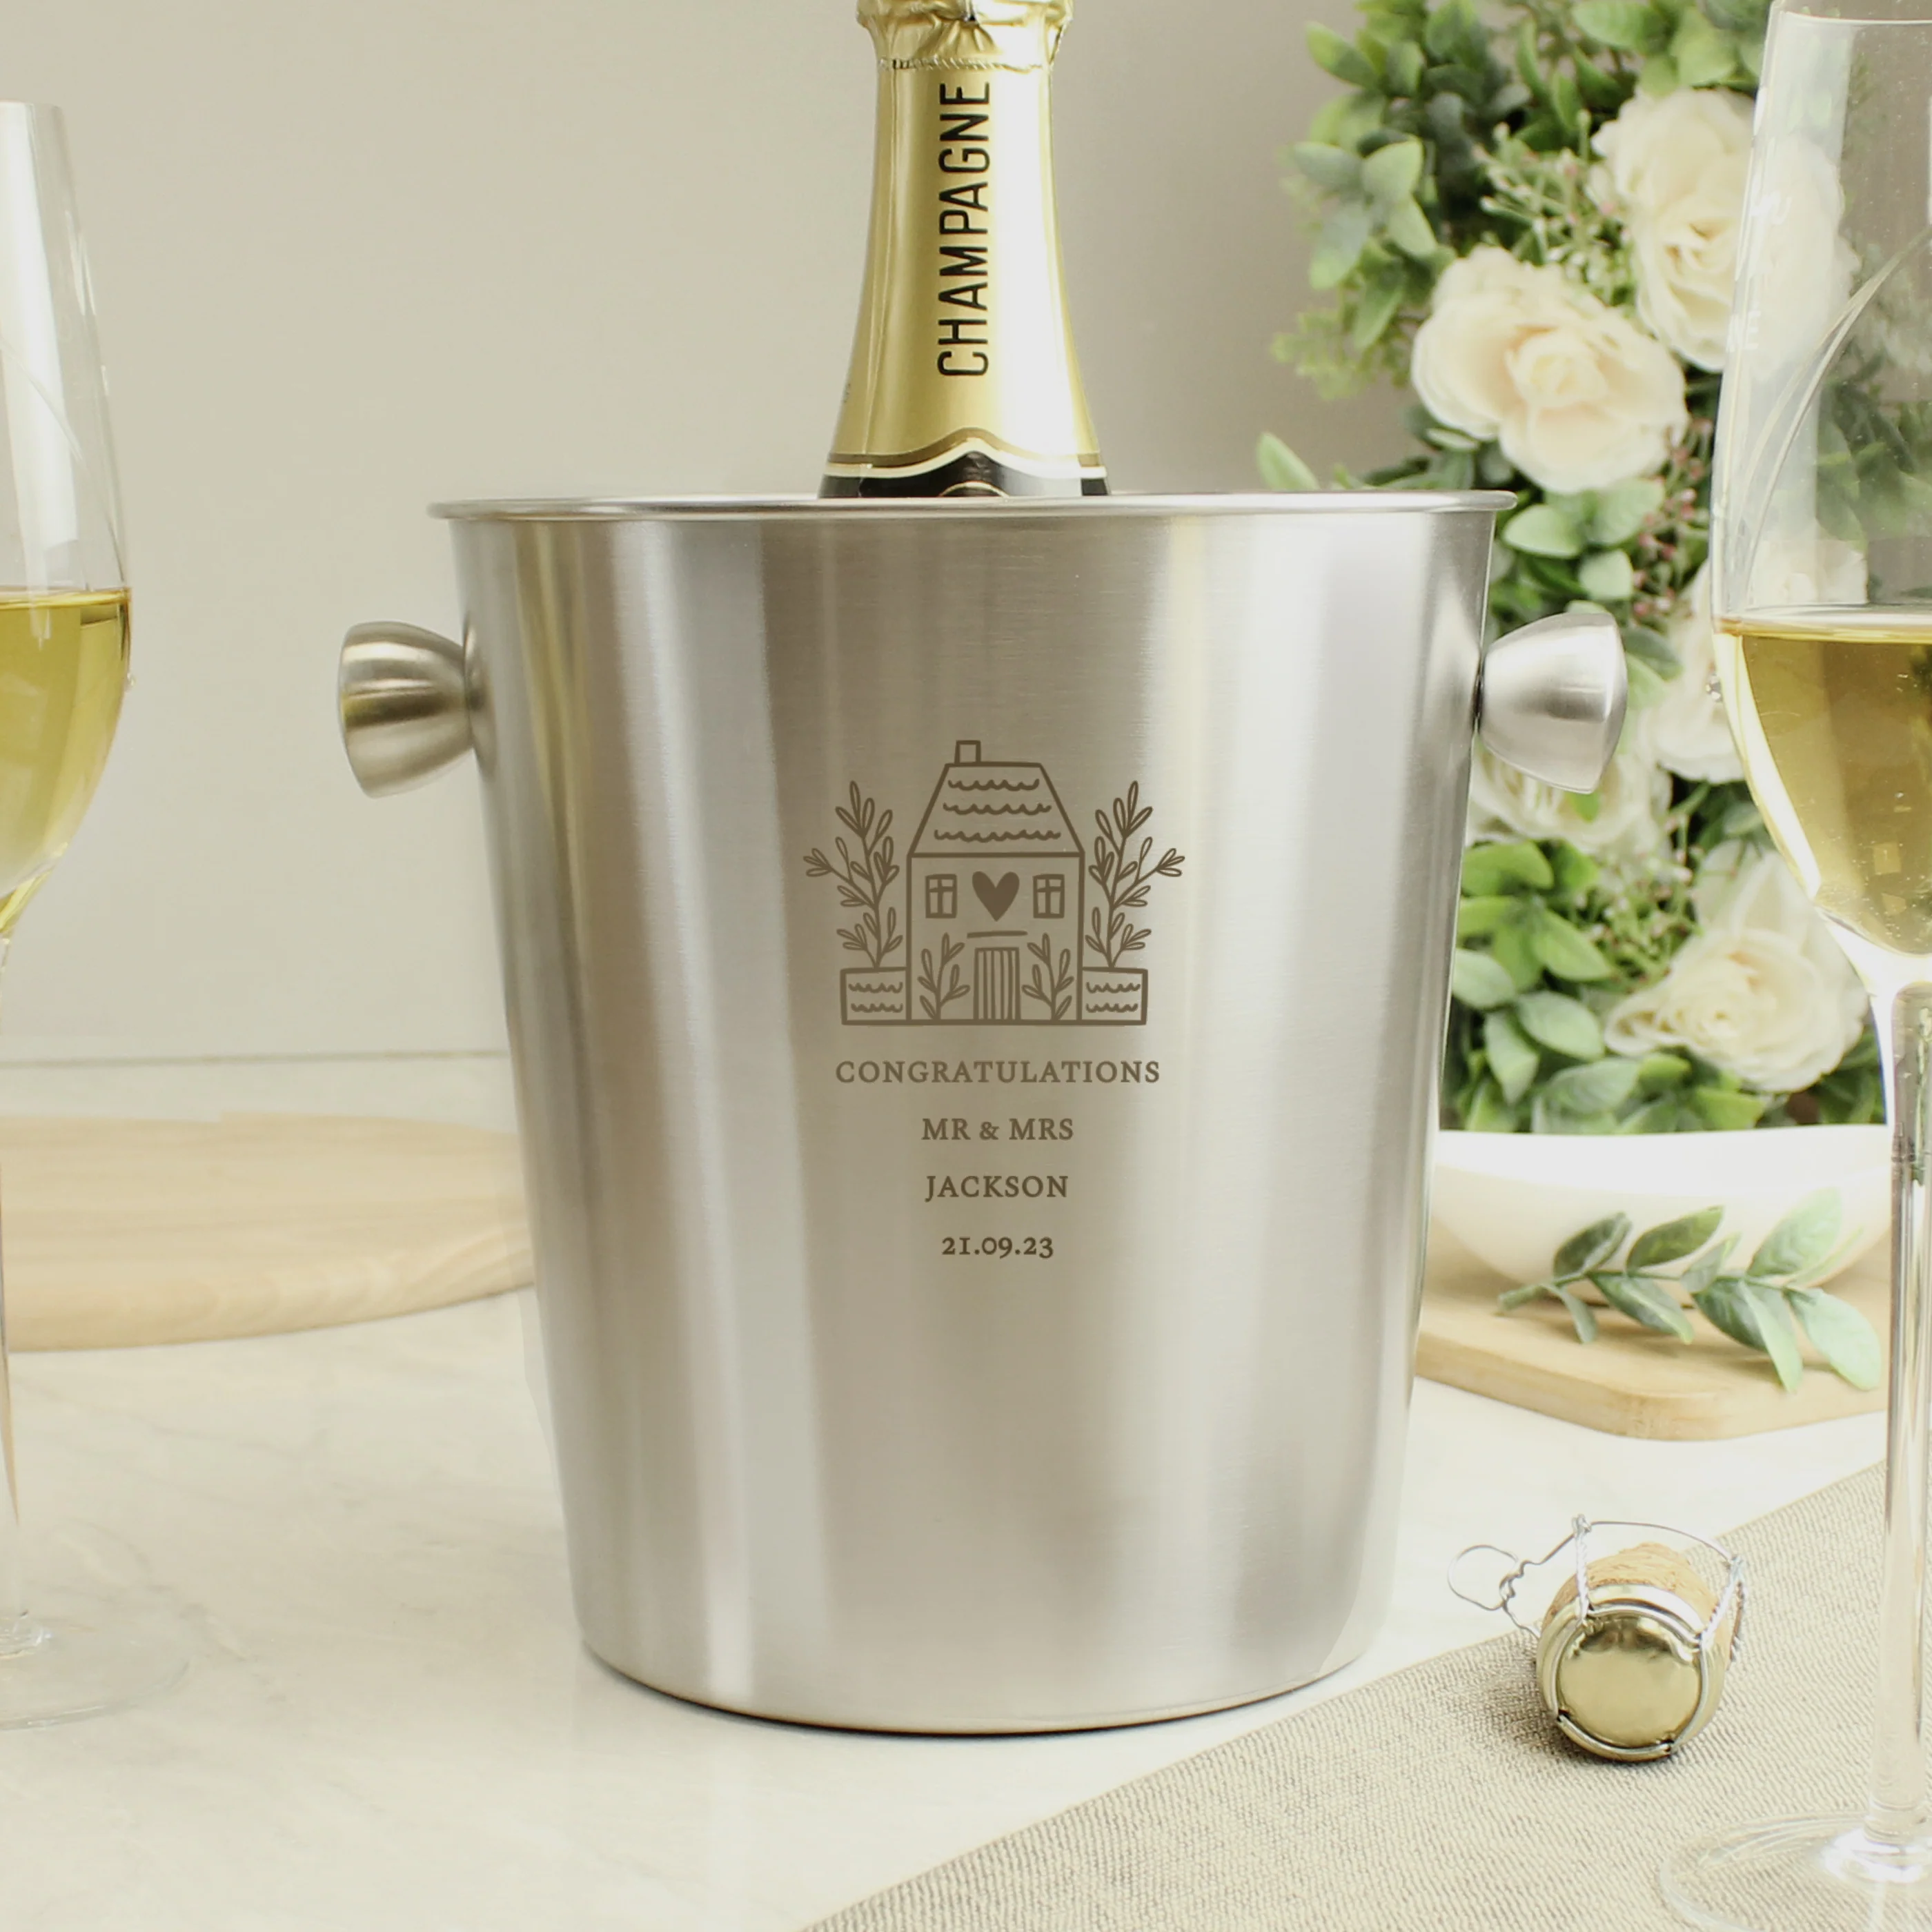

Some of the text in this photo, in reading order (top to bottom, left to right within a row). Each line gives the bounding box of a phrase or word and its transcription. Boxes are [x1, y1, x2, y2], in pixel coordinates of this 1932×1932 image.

[938, 82, 989, 377] CHAMPAGNE
[836, 1060, 1161, 1084] CONGRATULATIONS
[921, 1118, 1074, 1141] MR & MRS
[924, 1175, 1069, 1203] JACKSON
[941, 1236, 1054, 1260] 21.09.23
